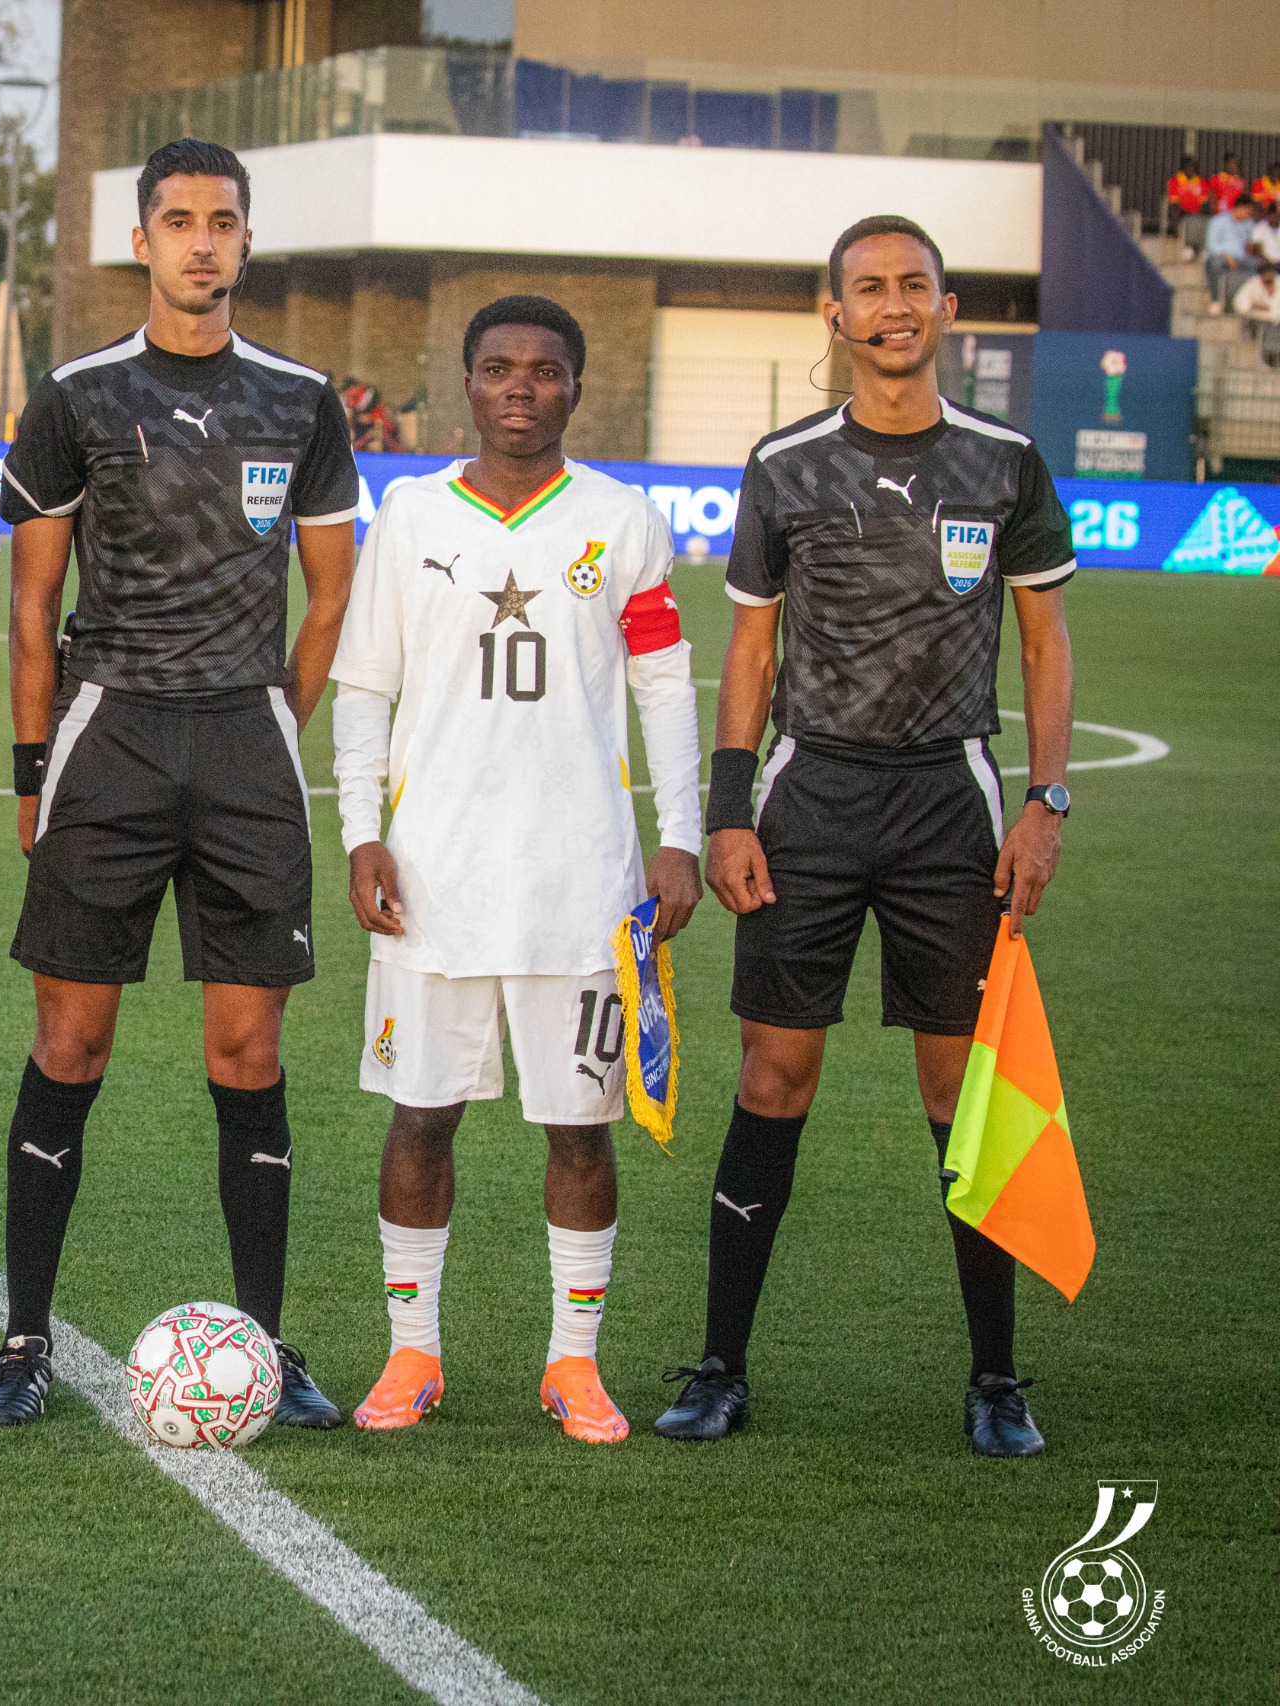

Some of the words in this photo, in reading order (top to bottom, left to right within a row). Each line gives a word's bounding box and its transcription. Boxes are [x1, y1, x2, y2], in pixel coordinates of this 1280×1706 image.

[248, 467, 287, 484] FIFA
[247, 496, 283, 505] REFEREE
[628, 484, 740, 536] TIO
[256, 520, 271, 528] 2026
[947, 526, 988, 544] FIFA
[947, 551, 986, 560] ASSISTANT
[950, 560, 982, 569] REFEREE
[954, 579, 972, 588] 2026
[479, 631, 546, 702] 10
[574, 990, 626, 1063] 10
